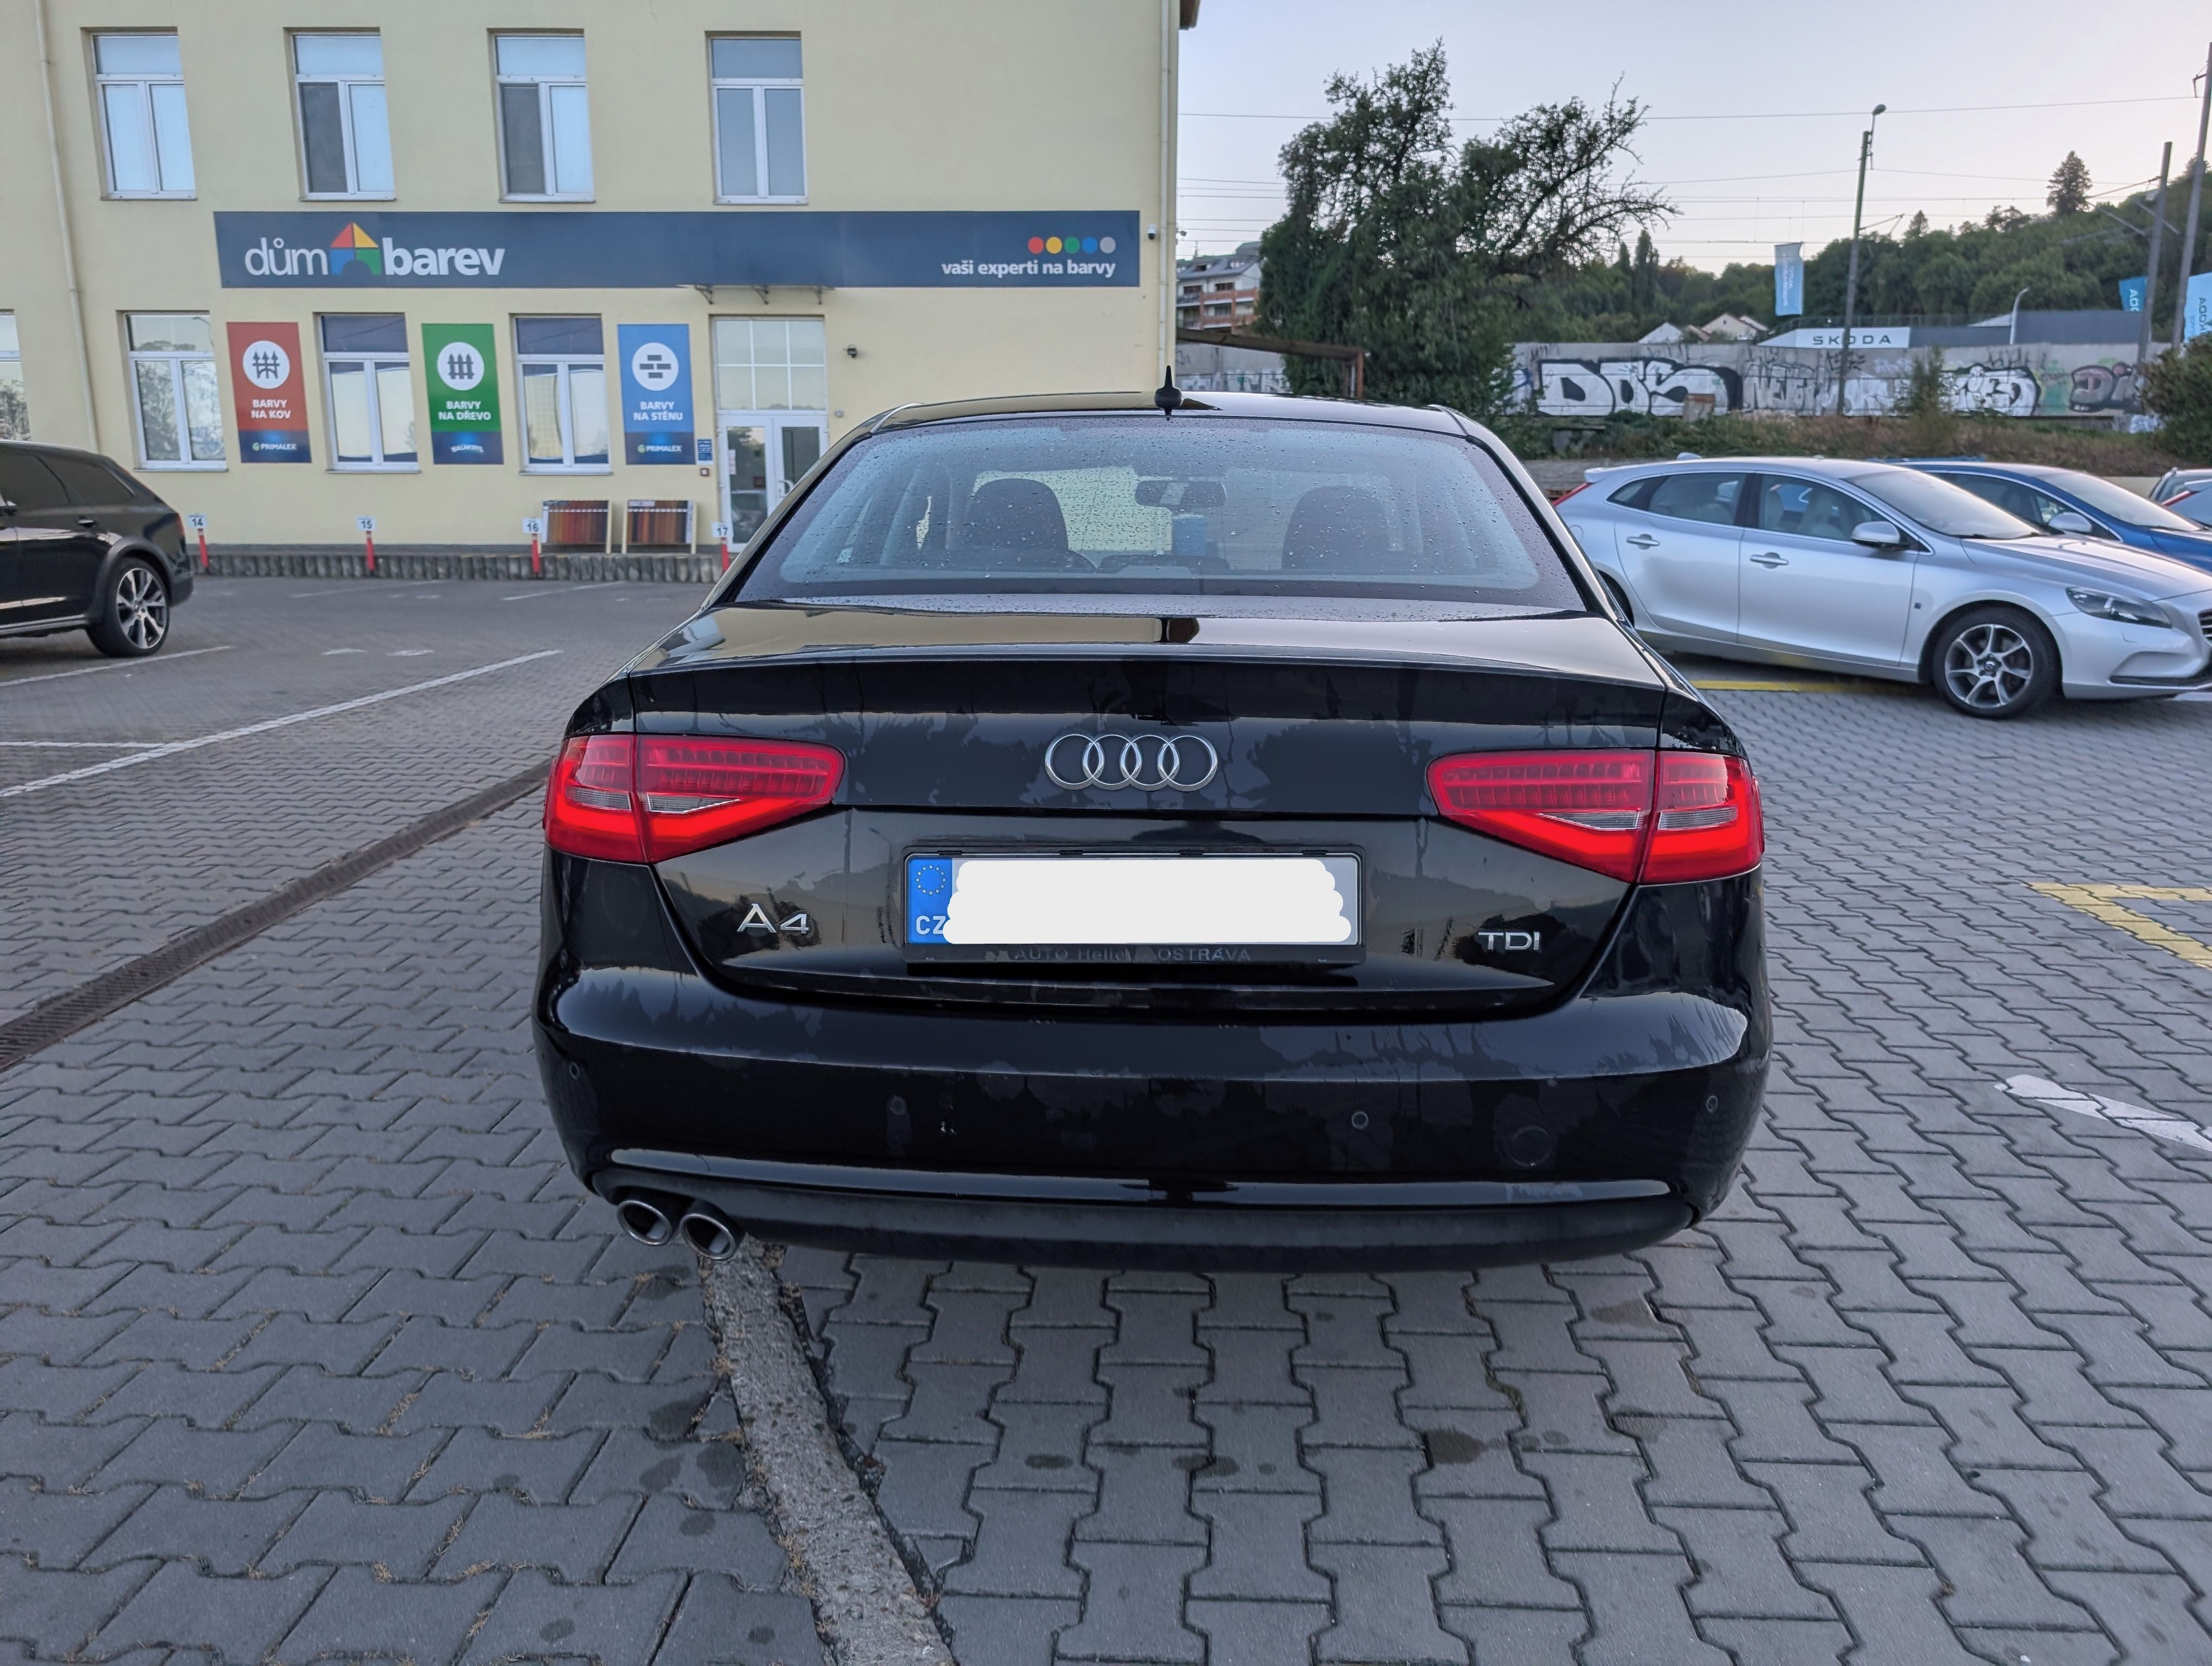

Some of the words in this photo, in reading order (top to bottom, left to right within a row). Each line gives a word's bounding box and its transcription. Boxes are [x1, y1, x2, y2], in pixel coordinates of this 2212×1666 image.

[244, 237, 329, 276] dům
[382, 237, 505, 276] barev
[941, 259, 974, 275] vaši
[978, 259, 1039, 278] experti
[1042, 262, 1063, 275] na
[1067, 259, 1116, 278] barvy
[252, 399, 287, 408] BARVY
[446, 401, 481, 409] BARVY
[639, 401, 675, 410] BARVY
[251, 409, 267, 419] NA
[268, 409, 291, 419] KOV
[438, 411, 455, 420] NA
[456, 410, 492, 420] DŘEVO
[633, 412, 650, 421] NA
[651, 410, 684, 421] STĚNU
[192, 518, 204, 527] 14
[361, 520, 372, 529] 15
[717, 527, 729, 536] 17
[736, 902, 810, 934] A4
[916, 915, 946, 935] CZ
[1478, 931, 1541, 951] TDI
[1015, 947, 1069, 960] AUTO
[1157, 947, 1251, 961] OSTRAVA
